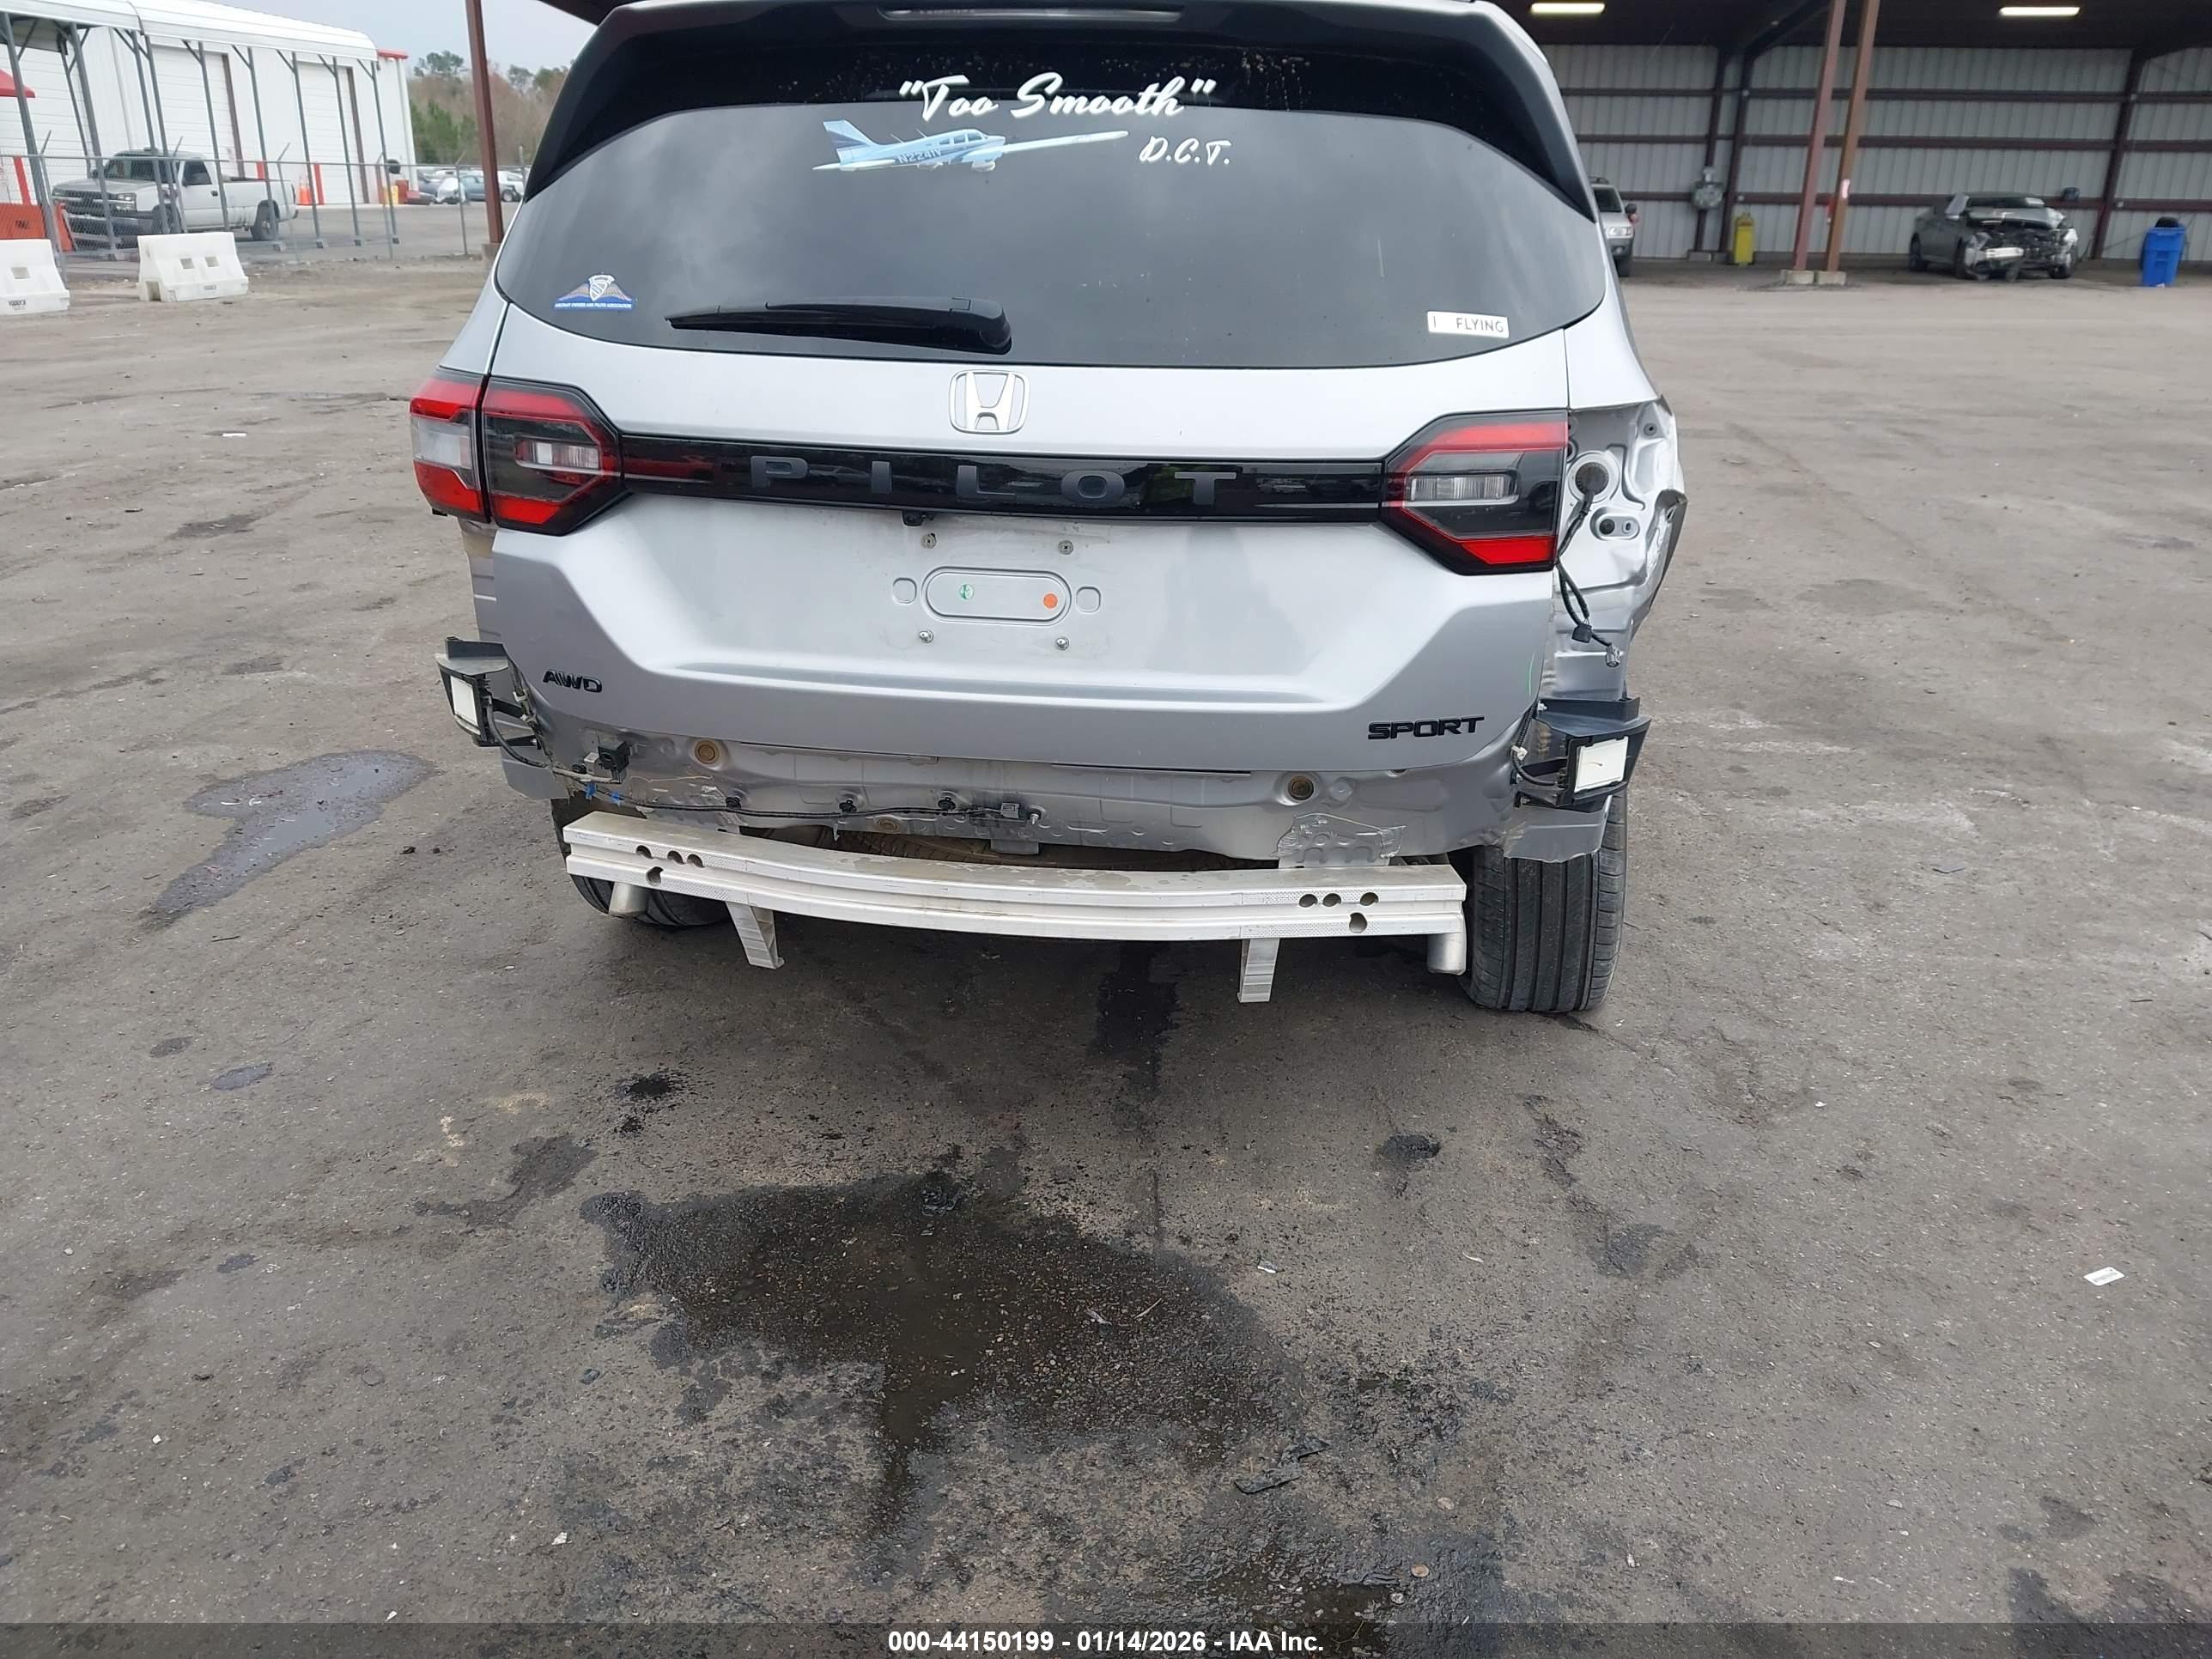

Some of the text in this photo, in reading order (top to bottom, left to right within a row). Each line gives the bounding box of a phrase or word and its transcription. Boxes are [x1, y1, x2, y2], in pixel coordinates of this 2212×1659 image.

[899, 71, 1217, 122] "Too Smooth"
[1139, 136, 1231, 165] D.C.T.
[1456, 317, 1504, 333] FLYING
[750, 455, 1237, 506] PILOT
[543, 670, 603, 693] AWD
[1368, 715, 1485, 739] SPORT
